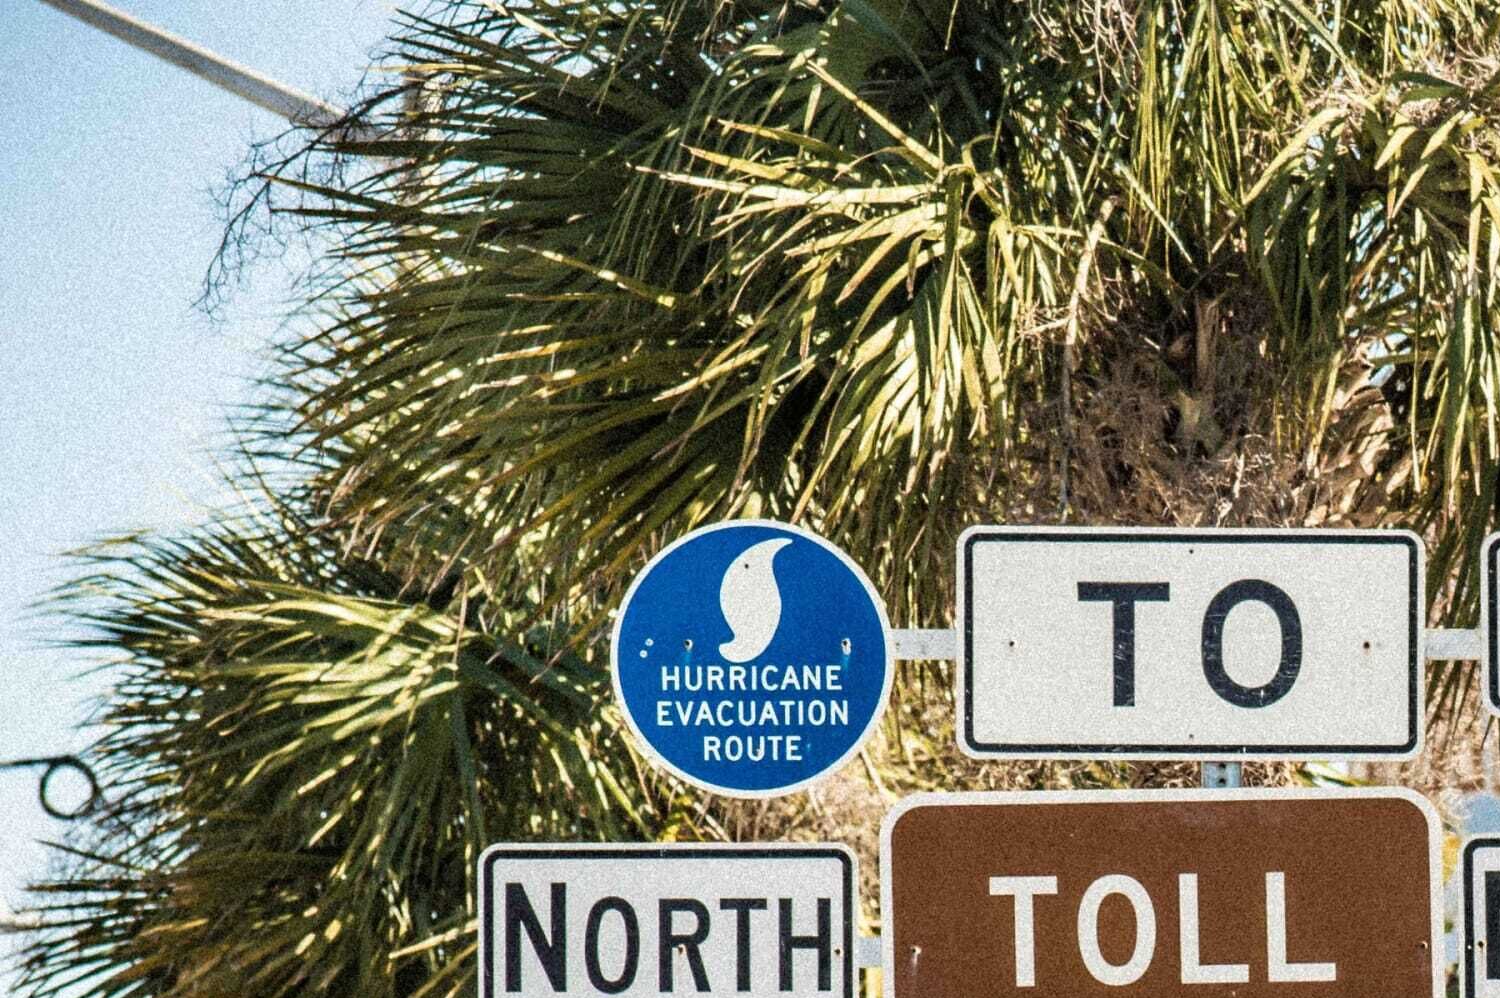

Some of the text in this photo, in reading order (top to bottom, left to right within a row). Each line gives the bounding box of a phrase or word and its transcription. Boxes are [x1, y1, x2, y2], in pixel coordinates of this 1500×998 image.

[661, 664, 842, 691] HURRICANE
[1077, 578, 1302, 708] TO
[656, 700, 849, 727] EVACUATION
[703, 735, 803, 761] ROUTE
[505, 882, 832, 993] NORTH
[989, 871, 1337, 988] TOLL
